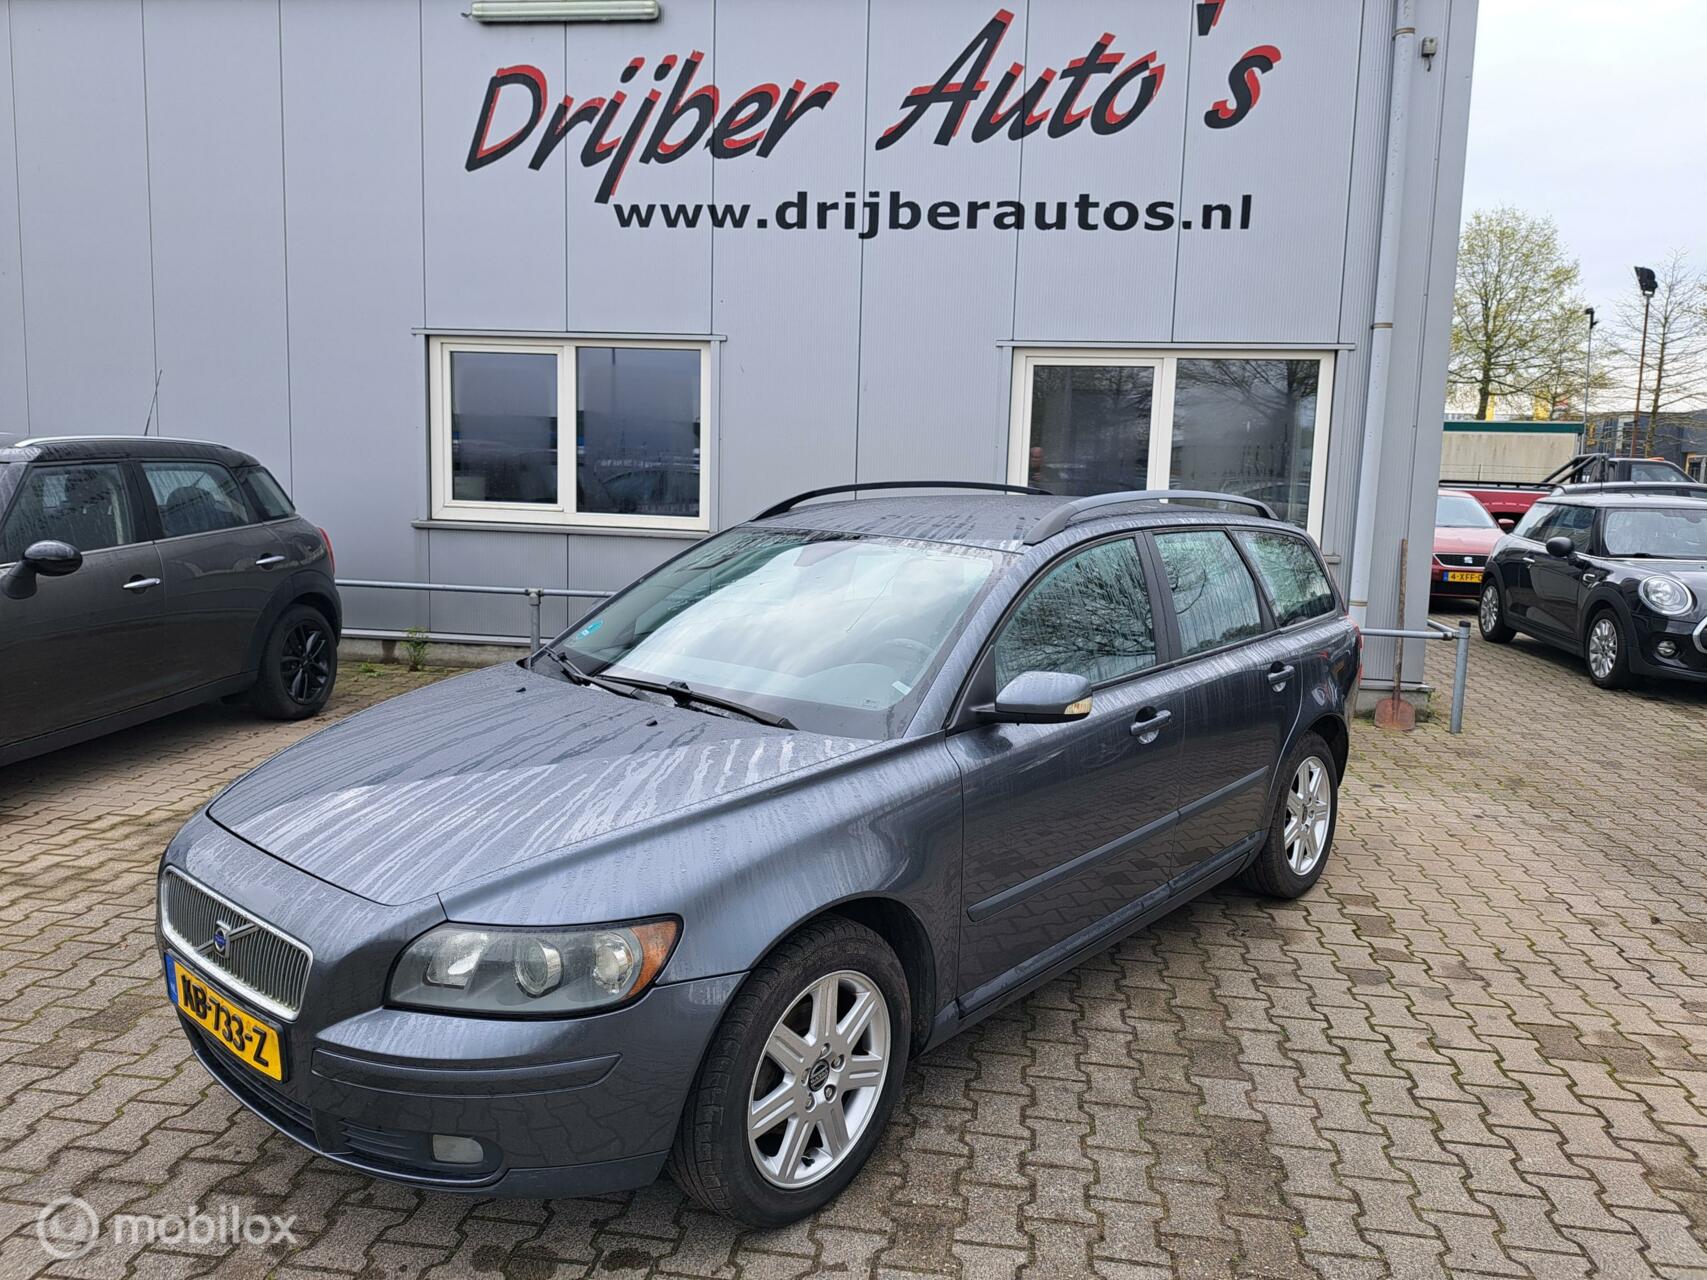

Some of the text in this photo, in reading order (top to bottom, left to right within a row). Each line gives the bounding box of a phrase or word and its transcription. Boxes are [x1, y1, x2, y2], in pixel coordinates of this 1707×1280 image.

[465, 0, 1282, 204] Drijber Auto's
[613, 191, 1252, 239] www.drijberautos.nl
[181, 974, 269, 1068] KB-733-Z
